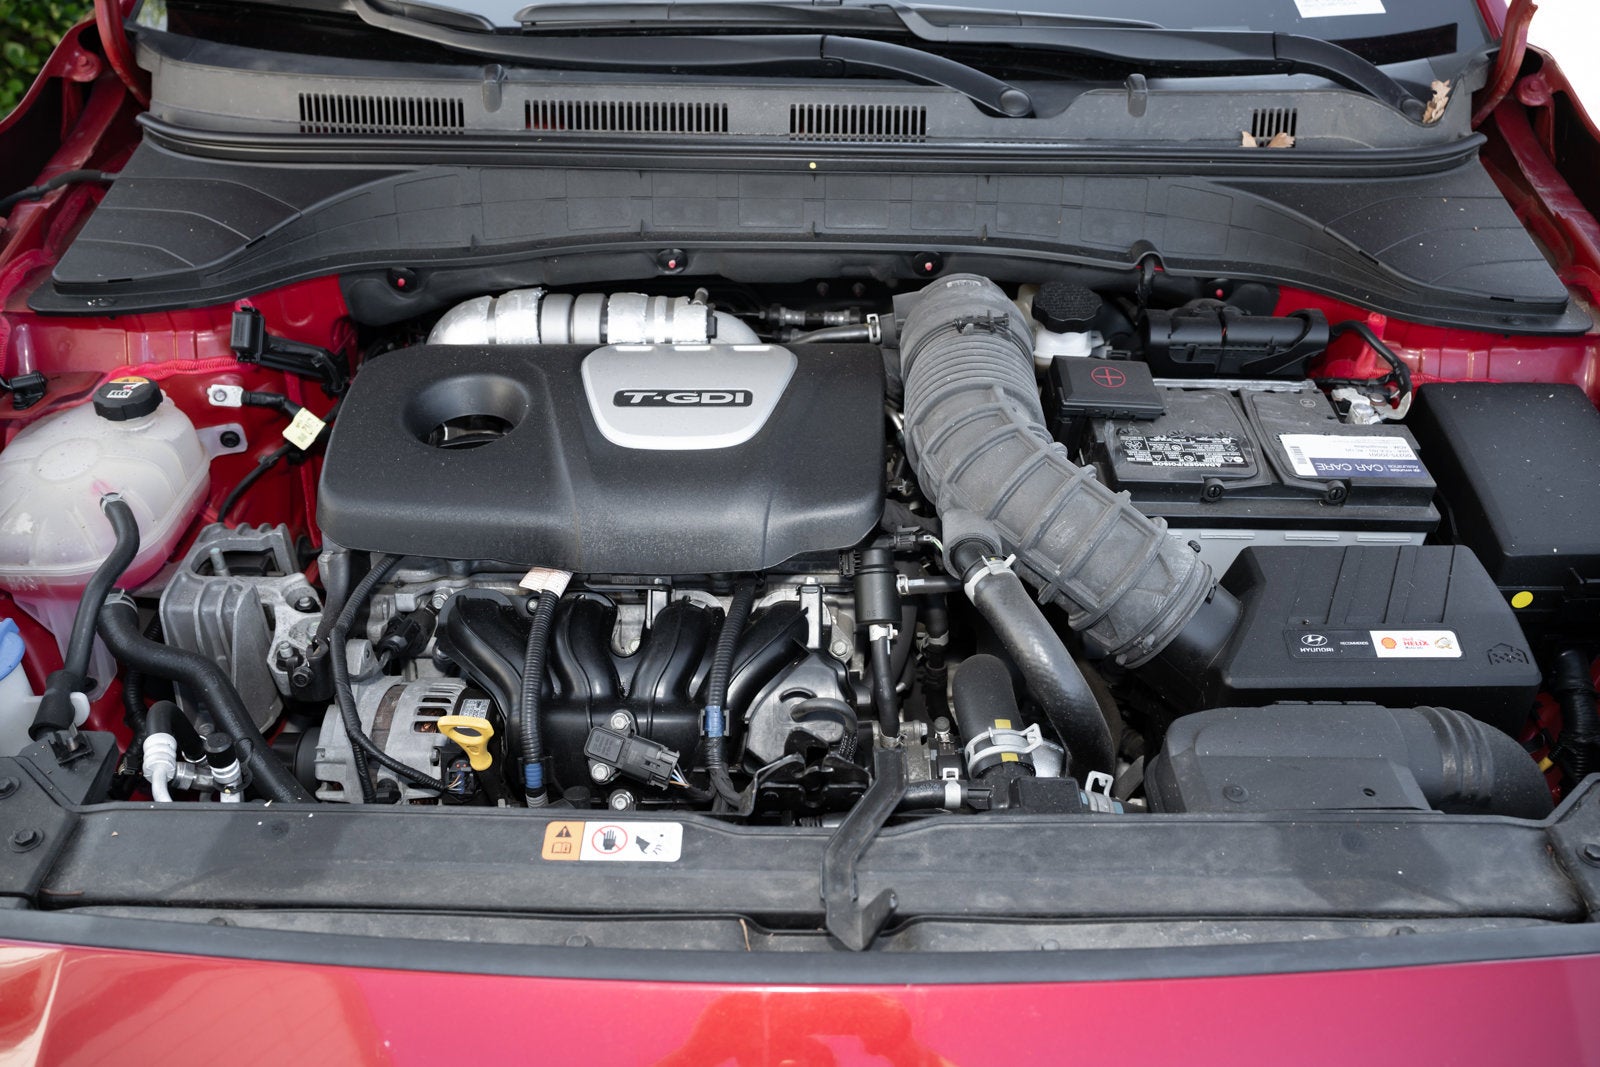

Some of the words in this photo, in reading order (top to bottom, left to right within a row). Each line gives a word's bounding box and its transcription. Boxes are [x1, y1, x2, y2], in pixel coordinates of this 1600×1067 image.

[623, 391, 745, 404] T-GDI
[1314, 462, 1352, 471] CARE
[1354, 463, 1384, 472] CAR
